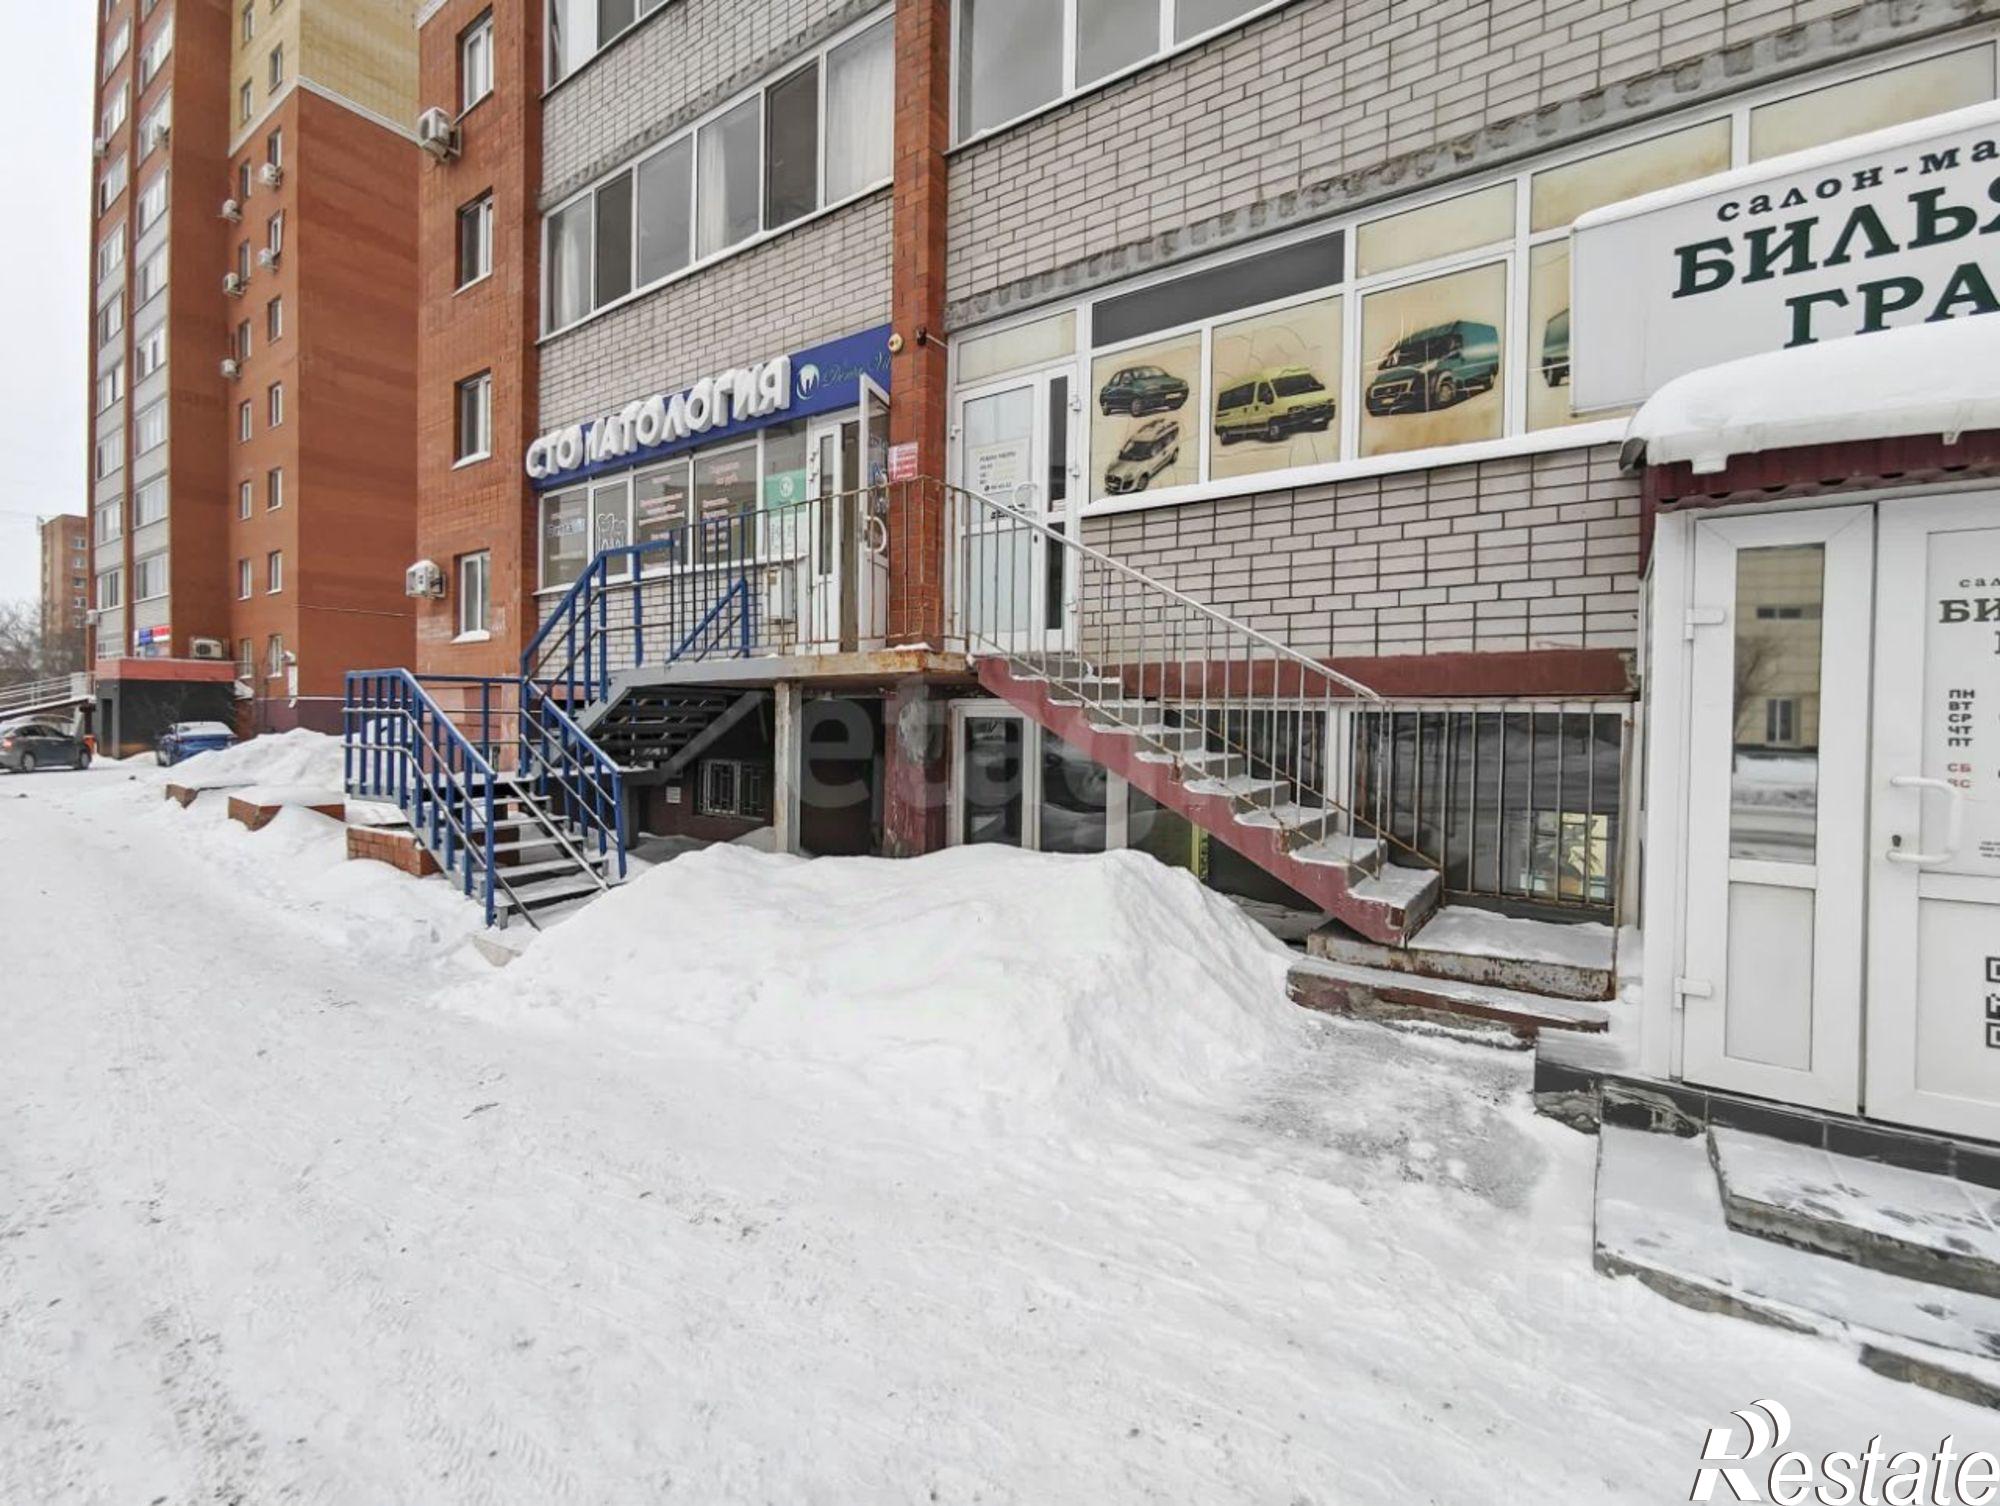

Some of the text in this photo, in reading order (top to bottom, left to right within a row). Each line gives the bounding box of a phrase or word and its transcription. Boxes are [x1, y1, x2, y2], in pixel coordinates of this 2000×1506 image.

[525, 355, 791, 479] СТОМАТОЛОГИЯ
[1949, 689, 1975, 699] ПН
[1948, 701, 1973, 711] ВТ
[1948, 713, 1973, 723] СР
[1947, 725, 1973, 735] ЧТ
[1947, 737, 1973, 747] ПТ
[1947, 763, 1972, 773] СБ
